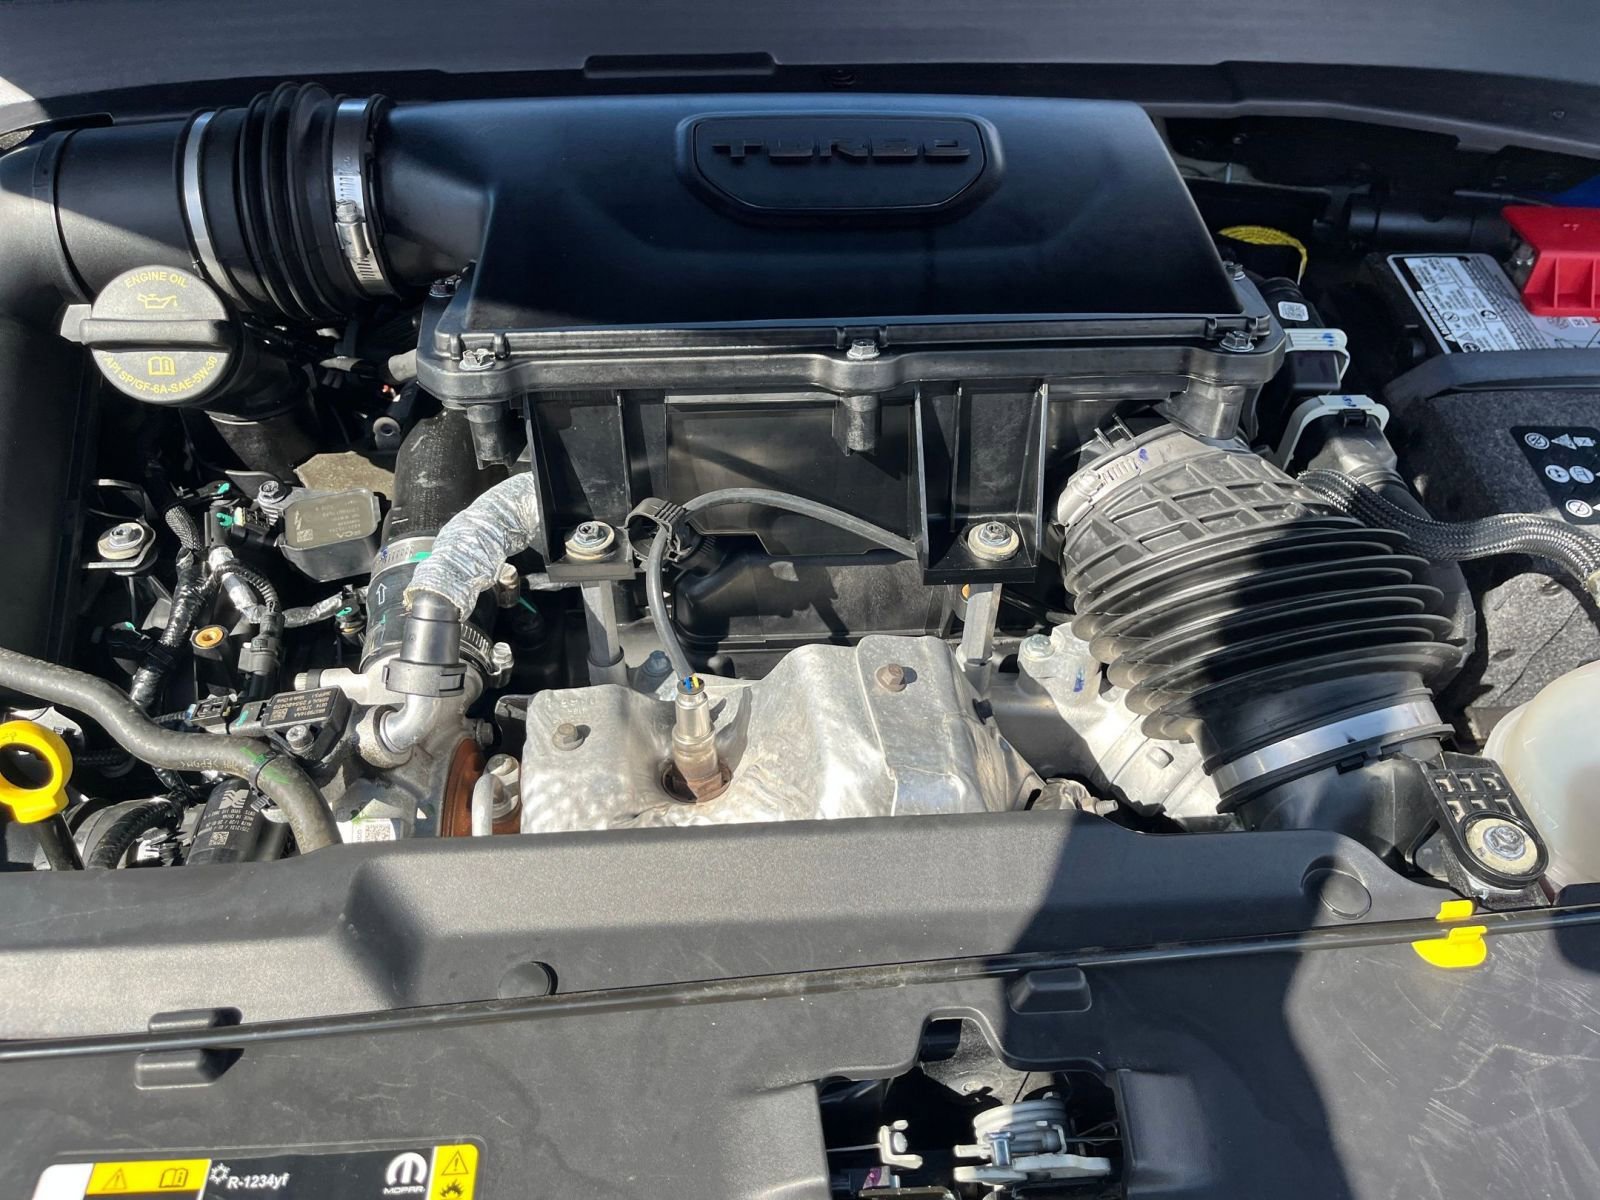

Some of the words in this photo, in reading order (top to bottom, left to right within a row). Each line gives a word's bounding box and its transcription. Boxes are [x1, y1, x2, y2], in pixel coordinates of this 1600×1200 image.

[125, 271, 168, 289] ENGINE
[169, 275, 188, 289] OIL
[104, 355, 120, 374] API
[226, 1172, 290, 1190] R-1234yf
[383, 1186, 424, 1195] MOPAR
